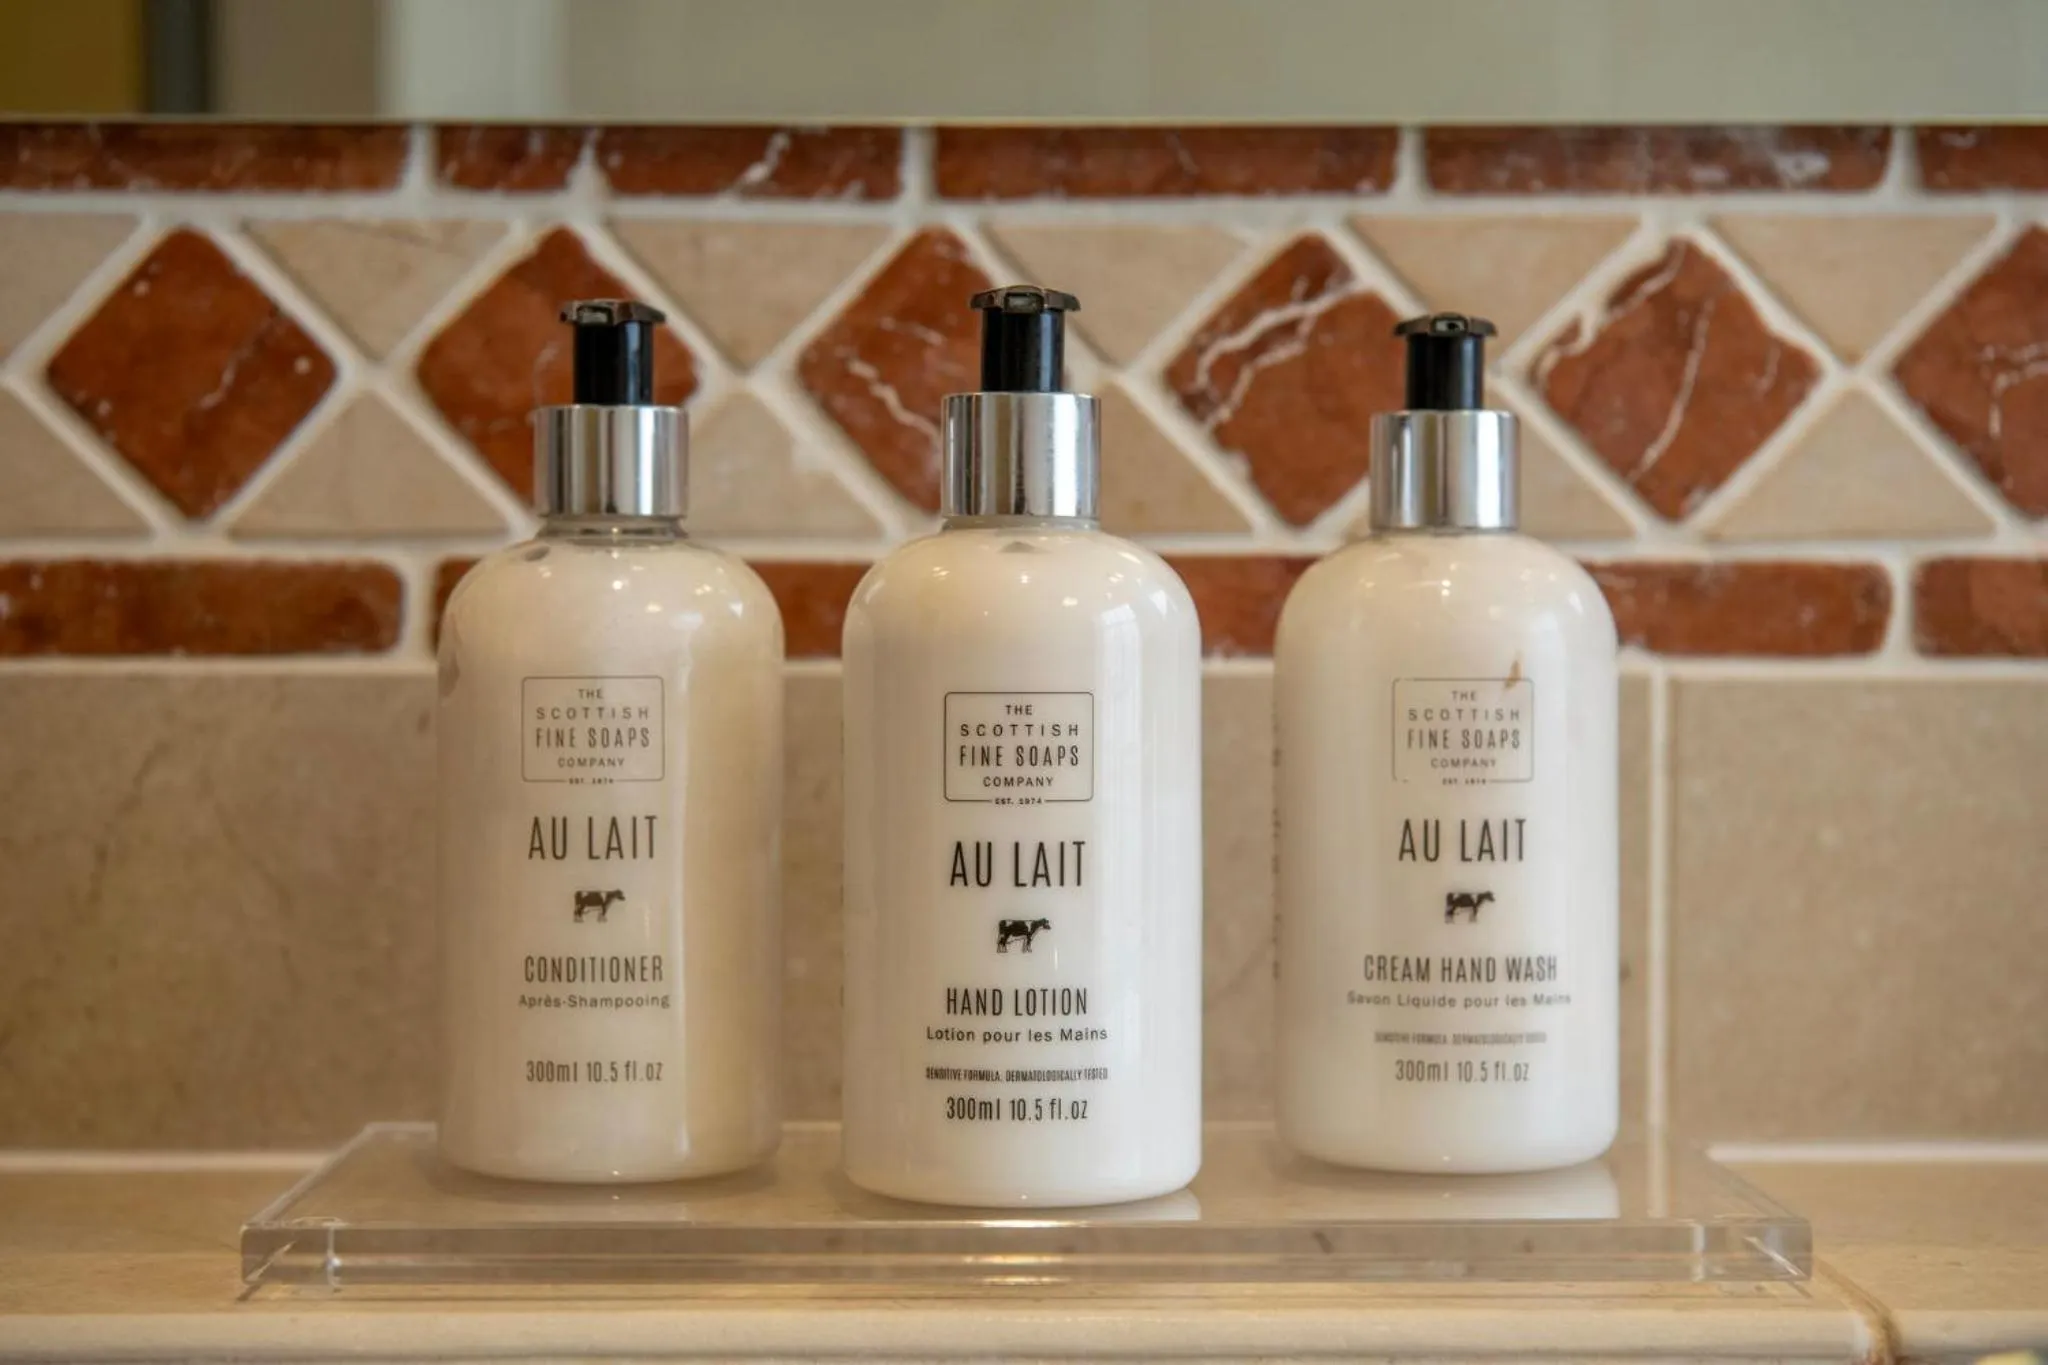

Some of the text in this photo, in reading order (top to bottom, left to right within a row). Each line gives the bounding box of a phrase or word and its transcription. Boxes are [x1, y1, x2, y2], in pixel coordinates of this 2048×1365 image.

[578, 688, 603, 699] THE
[1451, 691, 1477, 701] THE
[536, 707, 649, 720] SCOTTISH
[1005, 704, 1033, 716] THE
[1408, 708, 1520, 721] SCOTTISH
[536, 727, 651, 748] FINE SOAPS
[960, 724, 1078, 737] SCOTTISH
[1408, 728, 1520, 749] FINE SOAPS
[557, 757, 625, 768] COMPANY
[960, 745, 1079, 767] FINE SOAPS
[1431, 758, 1496, 769] COMPANY
[983, 776, 1053, 787] COMPANY
[528, 815, 657, 860] AU LAIT
[1399, 818, 1526, 862] AU LAIT
[950, 841, 1086, 887] AU LAIT
[524, 955, 663, 983] CONDITIONER
[1364, 954, 1557, 983] CREAM HAND WASH
[518, 994, 671, 1009] Après-Shampooing
[946, 987, 1087, 1016] HAND LOTION
[1347, 990, 1571, 1010] Savon Liquide pour les Mains
[926, 1026, 1108, 1044] Lotion pour les Mains
[526, 1060, 578, 1083] 300ml
[587, 1060, 618, 1083] 10.5
[926, 1066, 962, 1081] SENSITIVE
[1005, 1068, 1082, 1082] DERMATOLOGICALLY
[1084, 1067, 1108, 1080] TESTED
[1395, 1059, 1448, 1082] 300ml
[946, 1097, 1000, 1120] 300ml
[1009, 1098, 1043, 1121] 10.5
